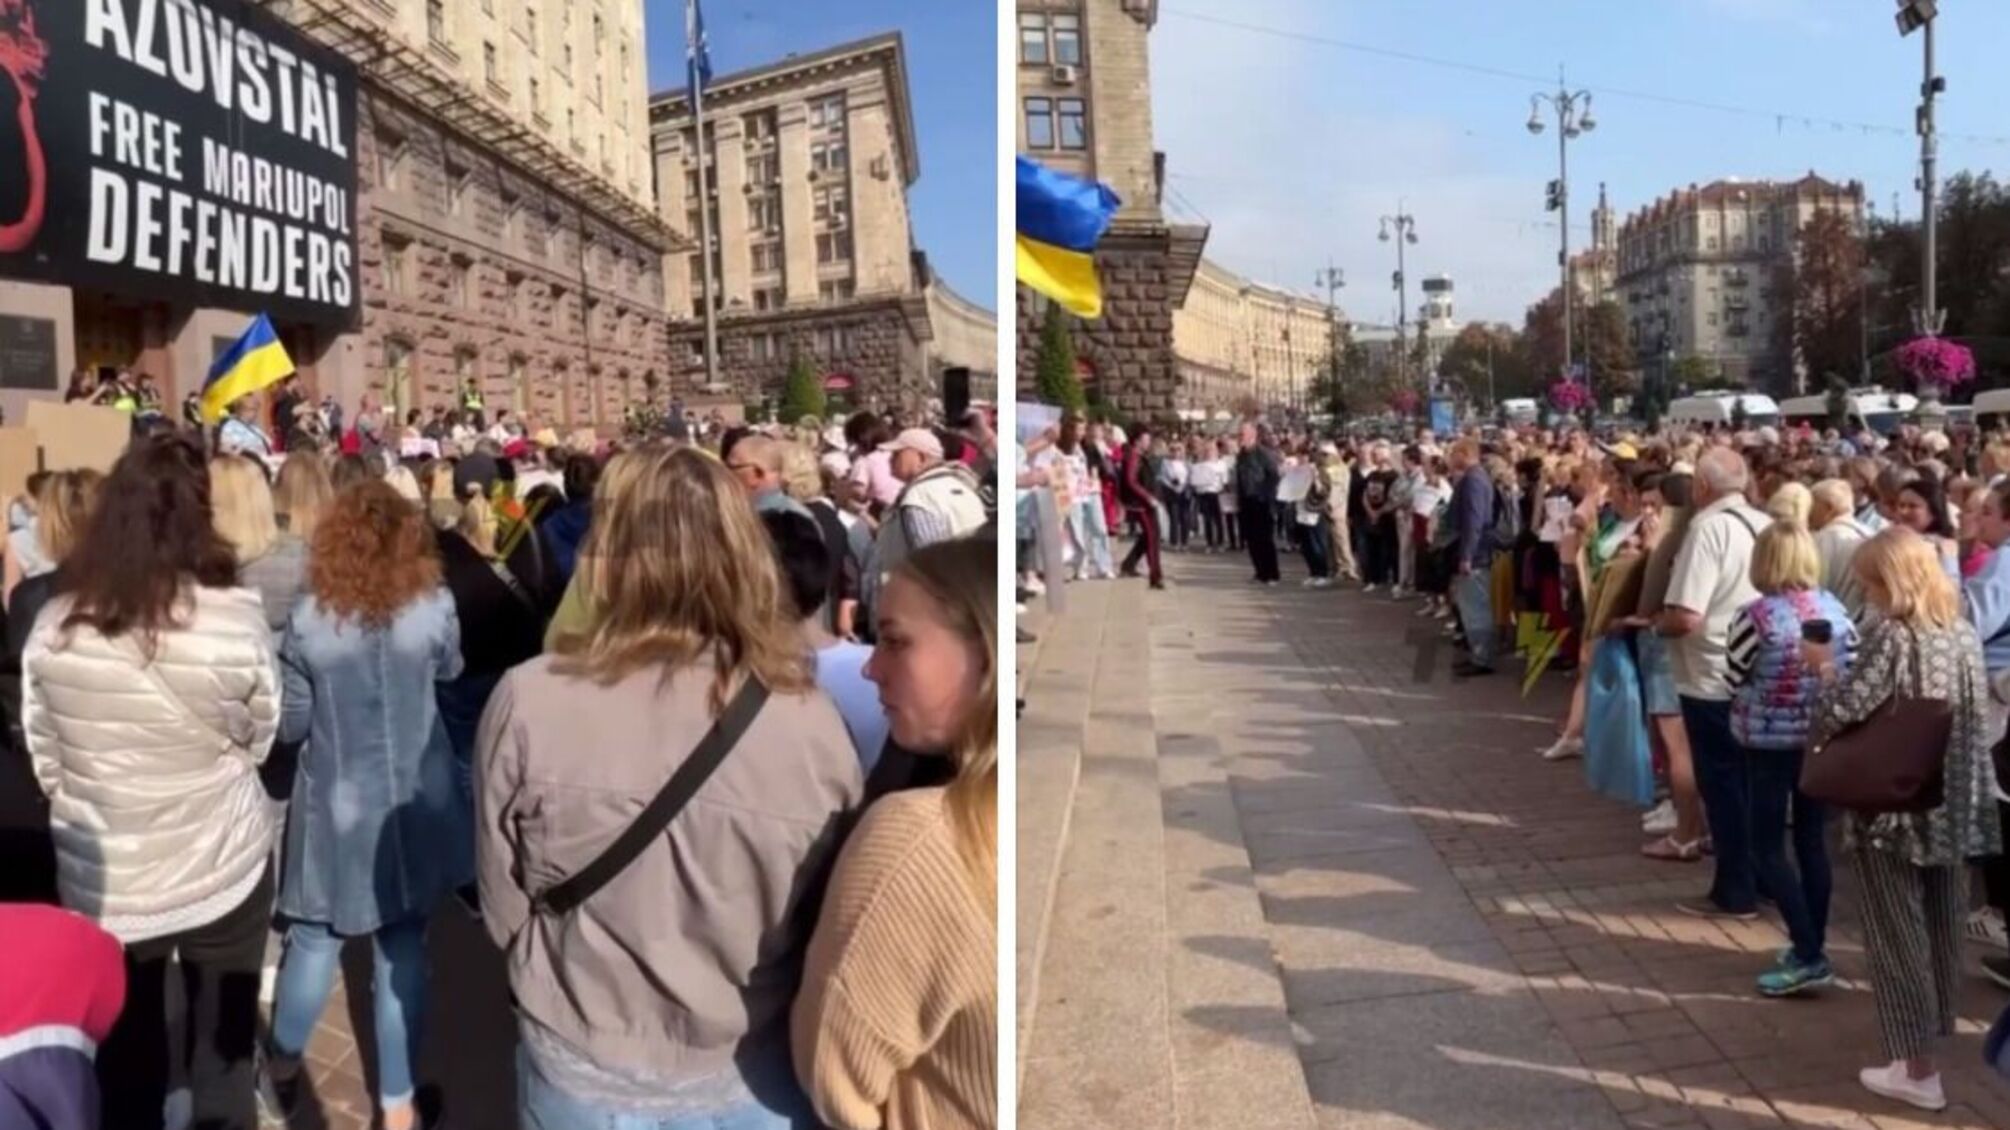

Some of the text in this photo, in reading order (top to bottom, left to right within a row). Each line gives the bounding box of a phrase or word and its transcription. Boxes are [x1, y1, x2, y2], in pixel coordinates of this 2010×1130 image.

[85, 0, 347, 158] AZOVSTAL
[89, 91, 350, 235] FREE MARIUPOL
[86, 166, 351, 308] DEFENDERS
